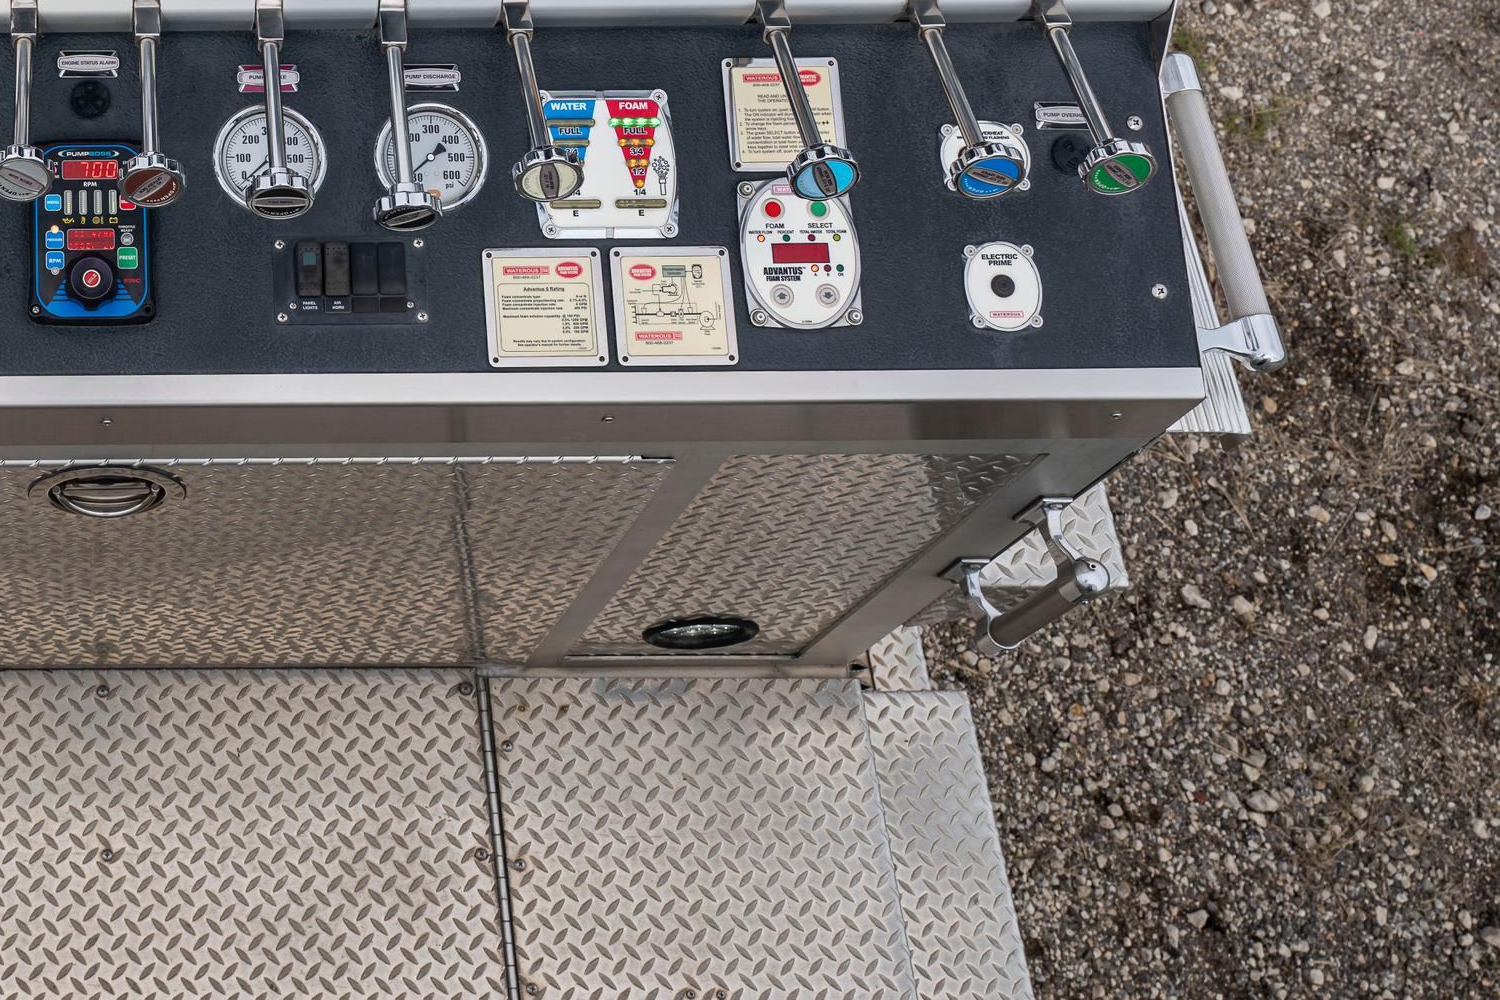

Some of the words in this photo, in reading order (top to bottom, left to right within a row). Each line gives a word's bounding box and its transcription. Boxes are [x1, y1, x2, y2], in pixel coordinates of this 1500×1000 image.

[551, 102, 587, 111] WATER
[619, 102, 648, 110] FOAM
[422, 124, 440, 134] 300
[559, 127, 582, 135] FULL
[624, 127, 647, 135] FULL
[242, 135, 260, 145] 200
[442, 135, 459, 145] 400
[630, 147, 644, 155] 3/4
[236, 153, 251, 163] 100
[287, 155, 304, 164] 500
[447, 153, 465, 162] 500
[80, 161, 117, 178] 700
[632, 168, 645, 176] 1/2
[443, 171, 461, 180] 600
[572, 209, 579, 217] E
[638, 209, 645, 217] E
[981, 253, 1018, 261] ELECTRIC
[988, 259, 1013, 267] PRIME
